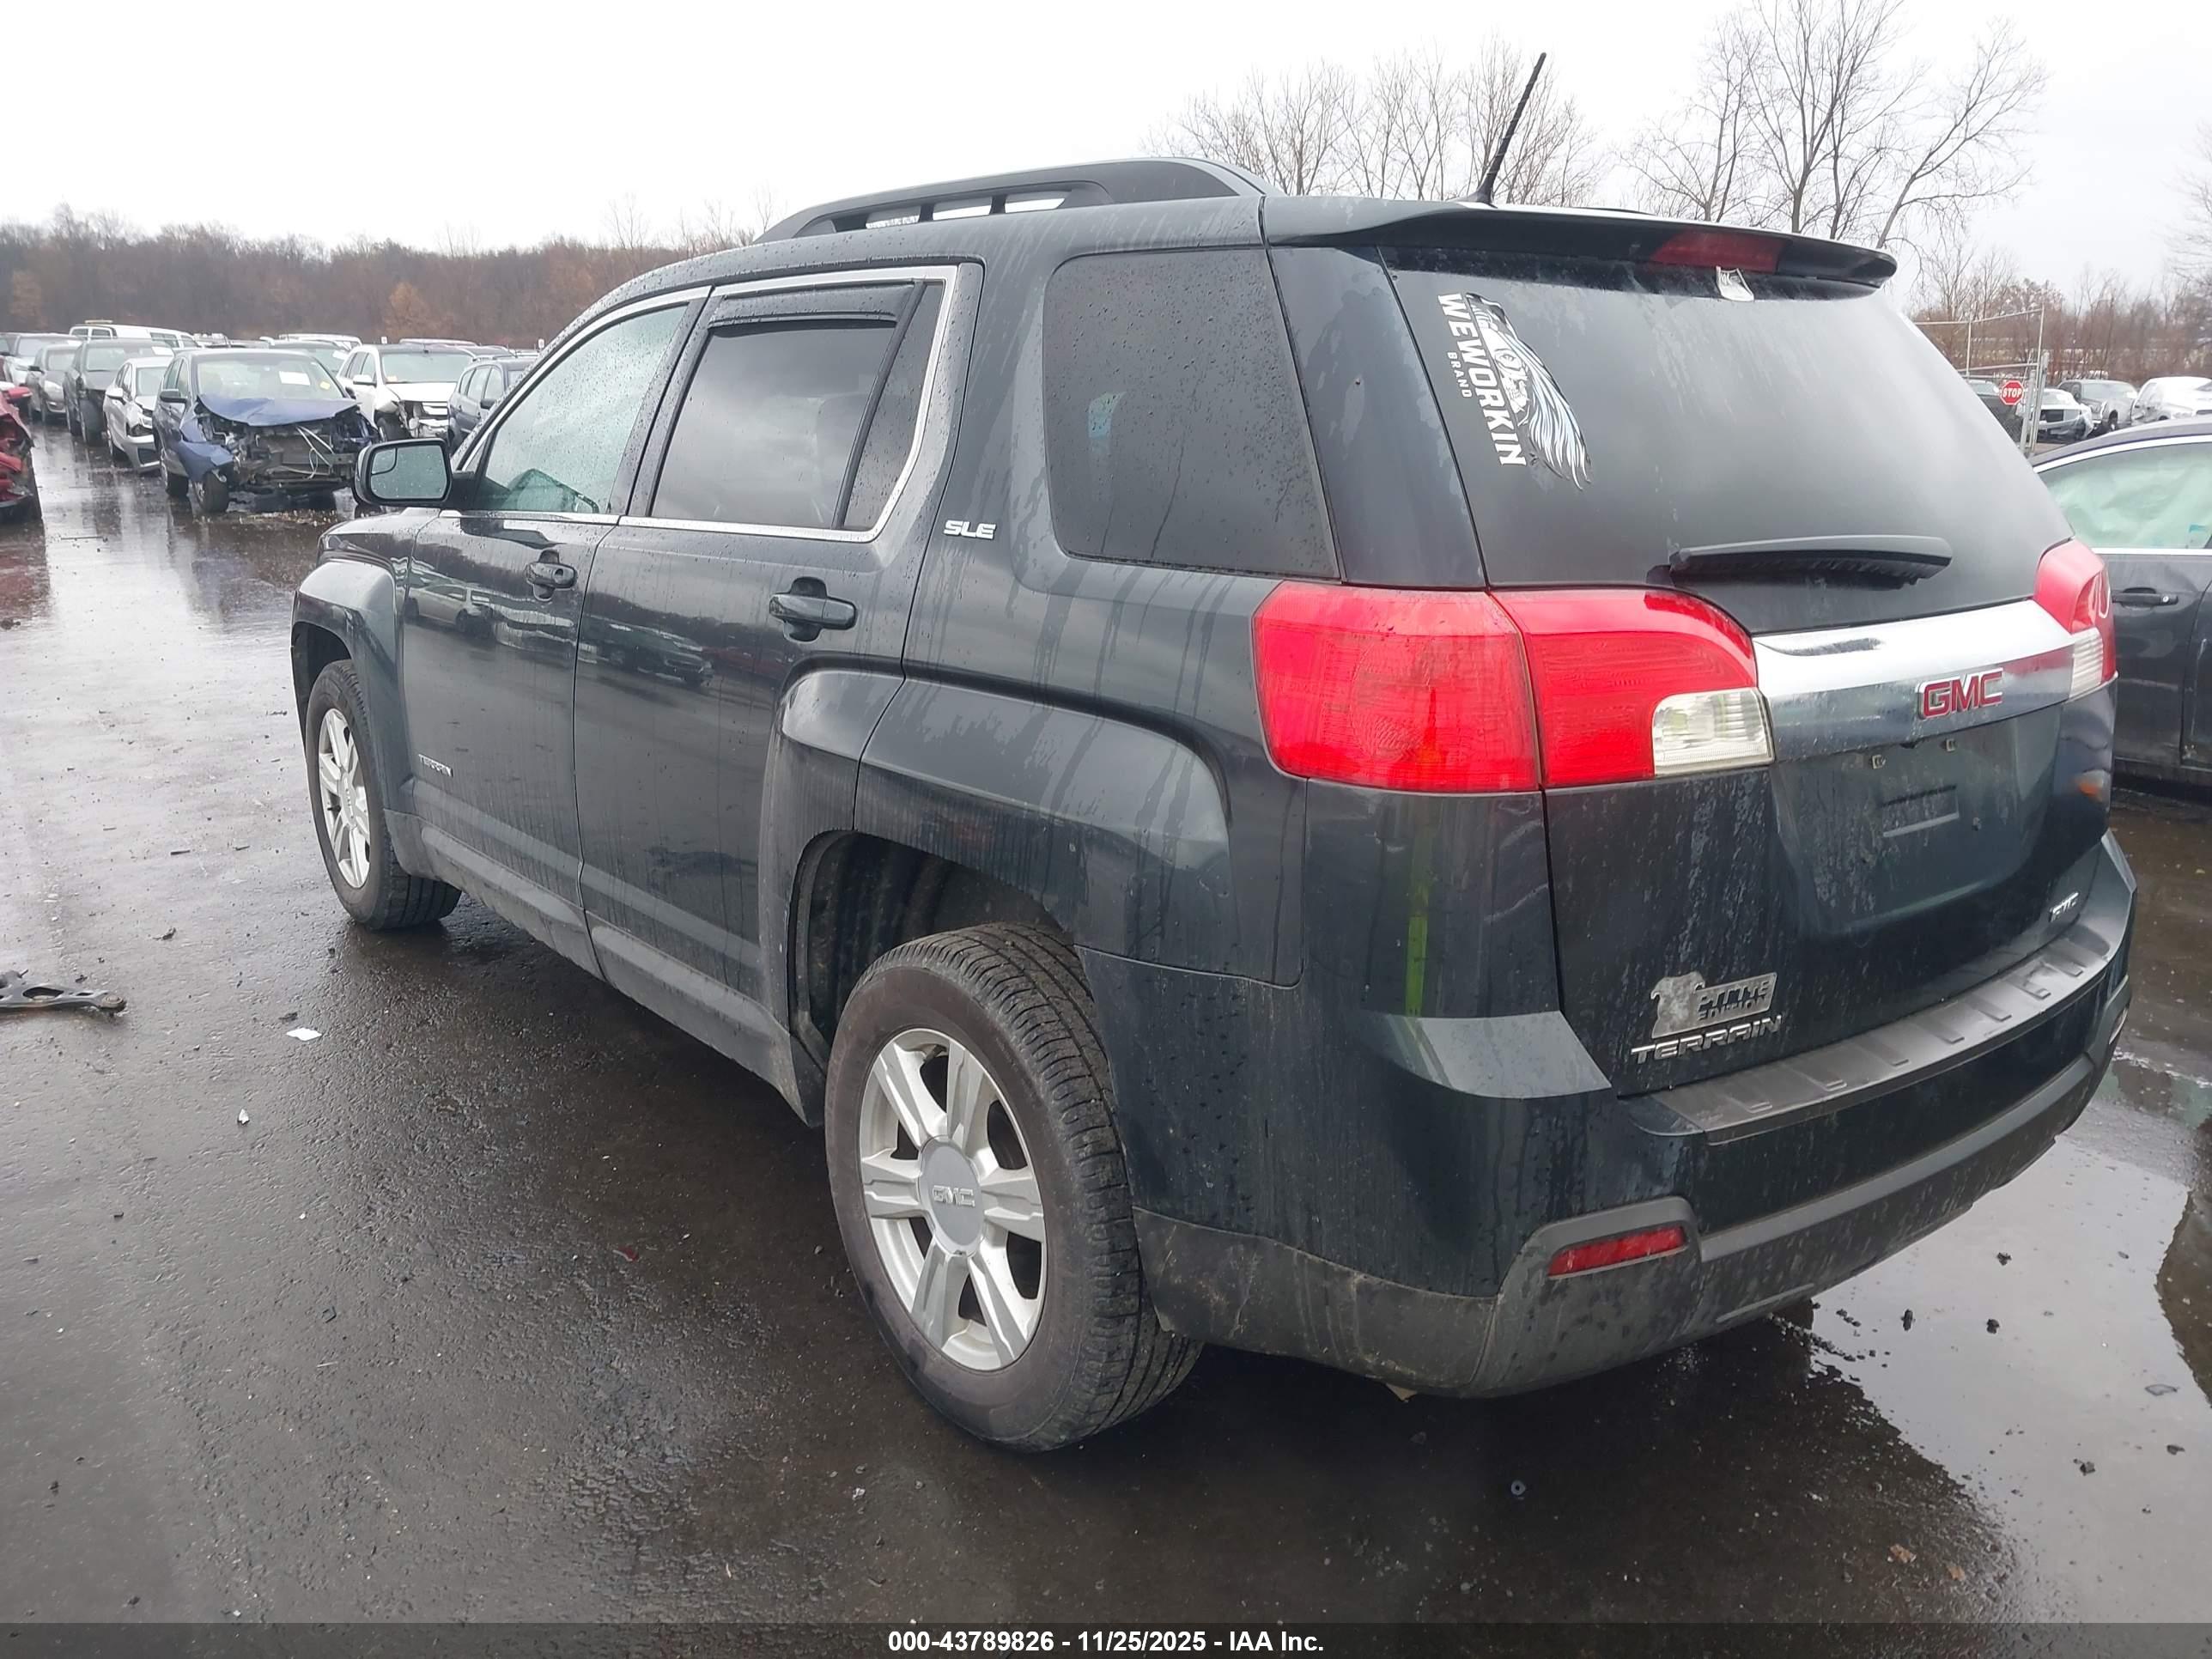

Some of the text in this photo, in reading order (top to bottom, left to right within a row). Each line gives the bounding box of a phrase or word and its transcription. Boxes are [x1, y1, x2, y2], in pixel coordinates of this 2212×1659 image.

[1447, 351, 1473, 398] BRAND
[2002, 387, 2022, 398] STOP
[944, 520, 996, 539] SLE
[1915, 667, 2003, 720] GMC
[1631, 1015, 1782, 1064] TERRAIN
[933, 1185, 975, 1207] GMC
